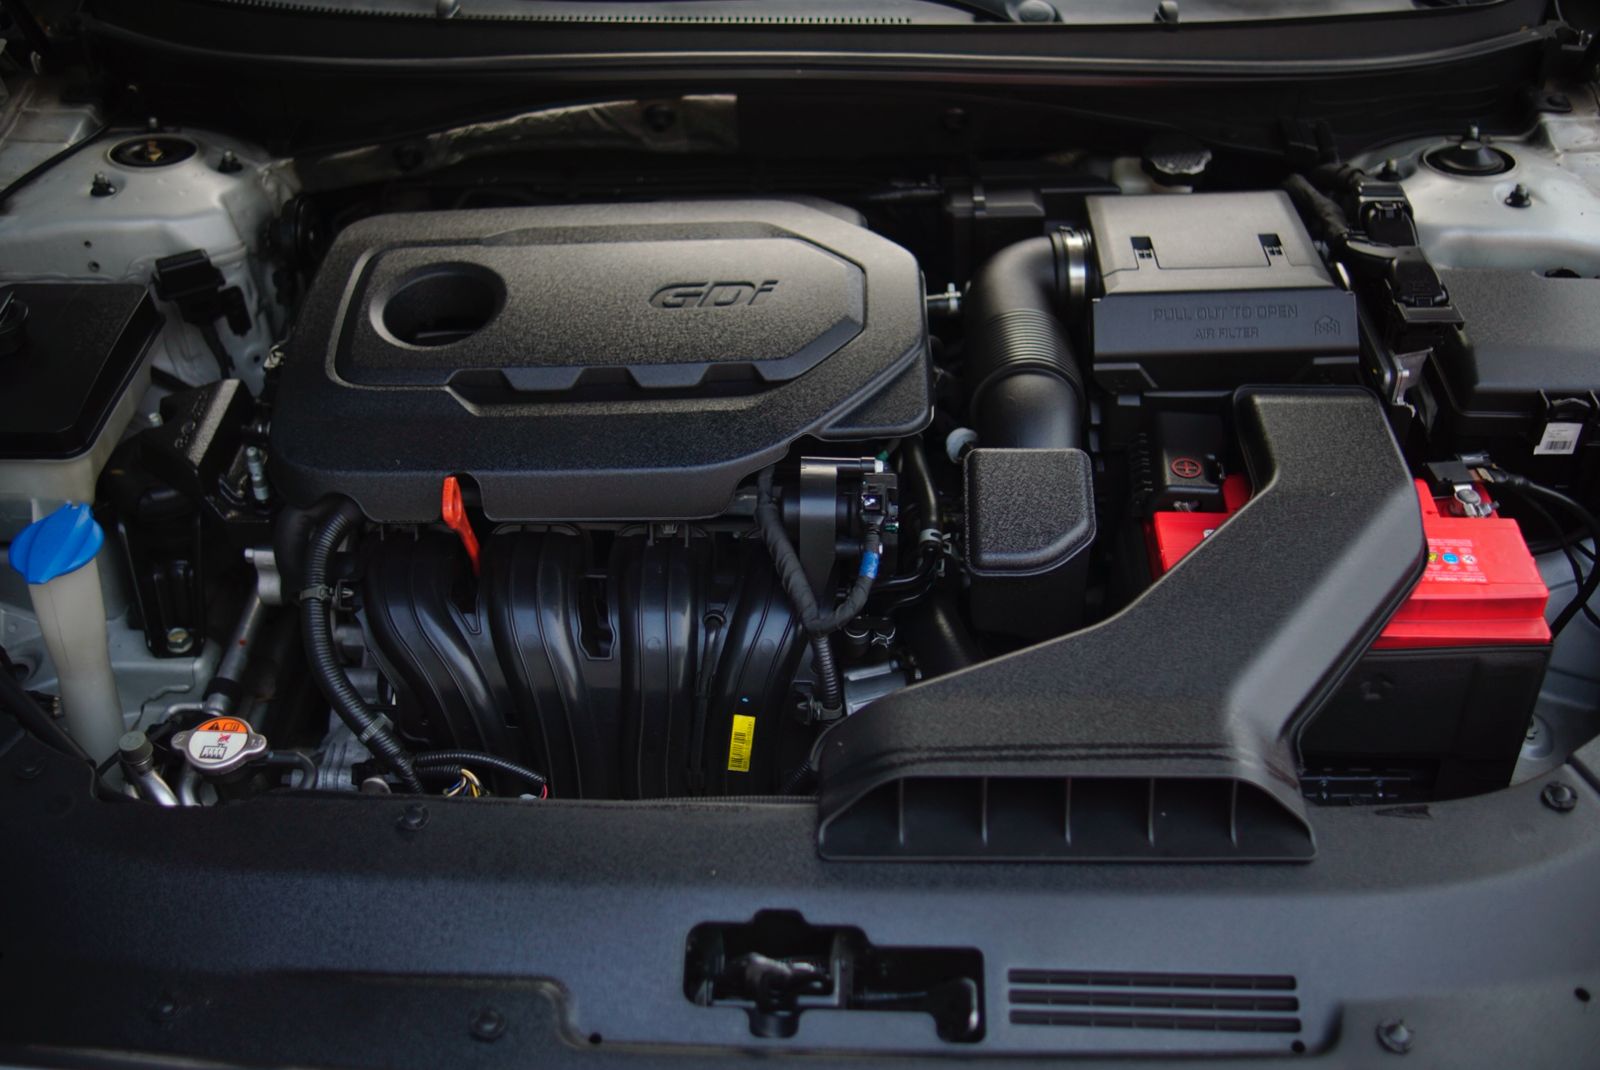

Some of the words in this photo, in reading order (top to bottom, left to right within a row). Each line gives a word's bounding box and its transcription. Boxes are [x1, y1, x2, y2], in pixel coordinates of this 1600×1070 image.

[1153, 305, 1192, 321] PULL
[1197, 305, 1226, 320] OUT
[1230, 304, 1252, 320] TO
[1256, 304, 1298, 319] OPEN
[1195, 328, 1215, 340] AIR
[1218, 327, 1259, 339] FILTER
